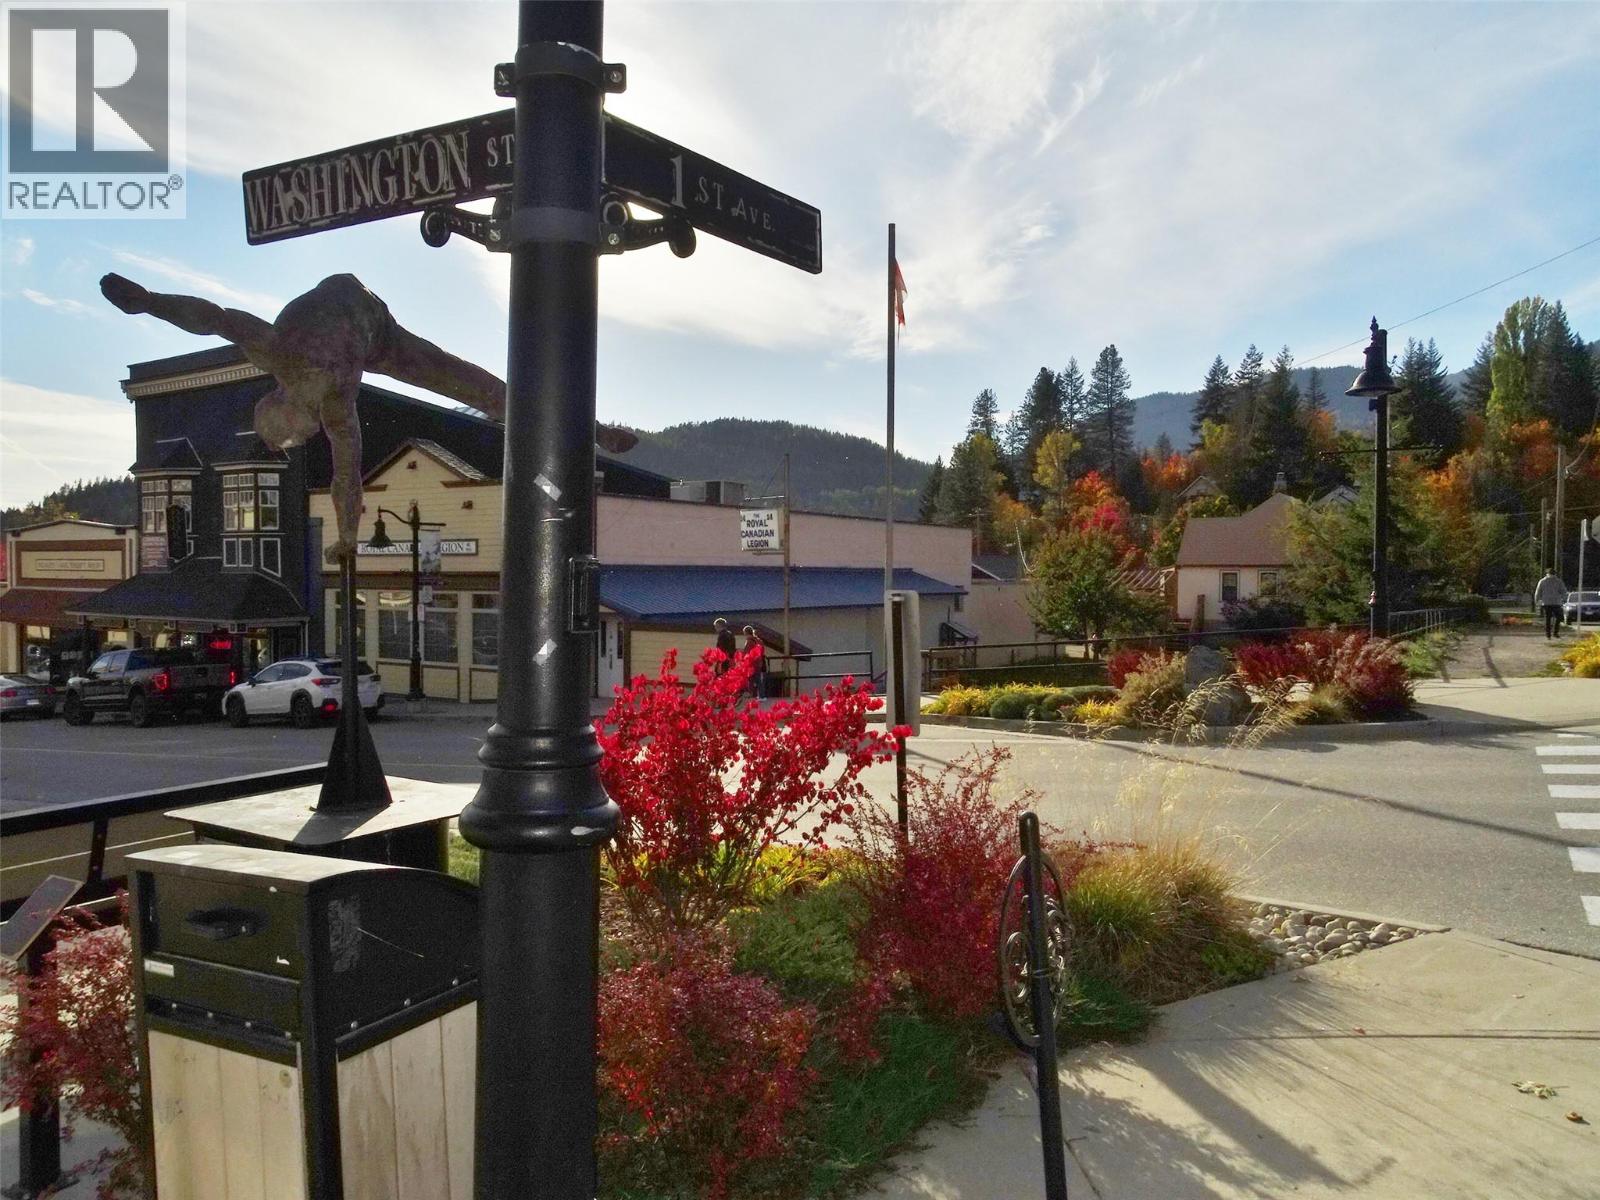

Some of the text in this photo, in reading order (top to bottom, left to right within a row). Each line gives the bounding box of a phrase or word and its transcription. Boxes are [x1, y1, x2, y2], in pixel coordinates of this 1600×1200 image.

[245, 131, 471, 231] WASHINGTON
[741, 529, 774, 538] CANADIAN
[747, 540, 769, 548] LEGION
